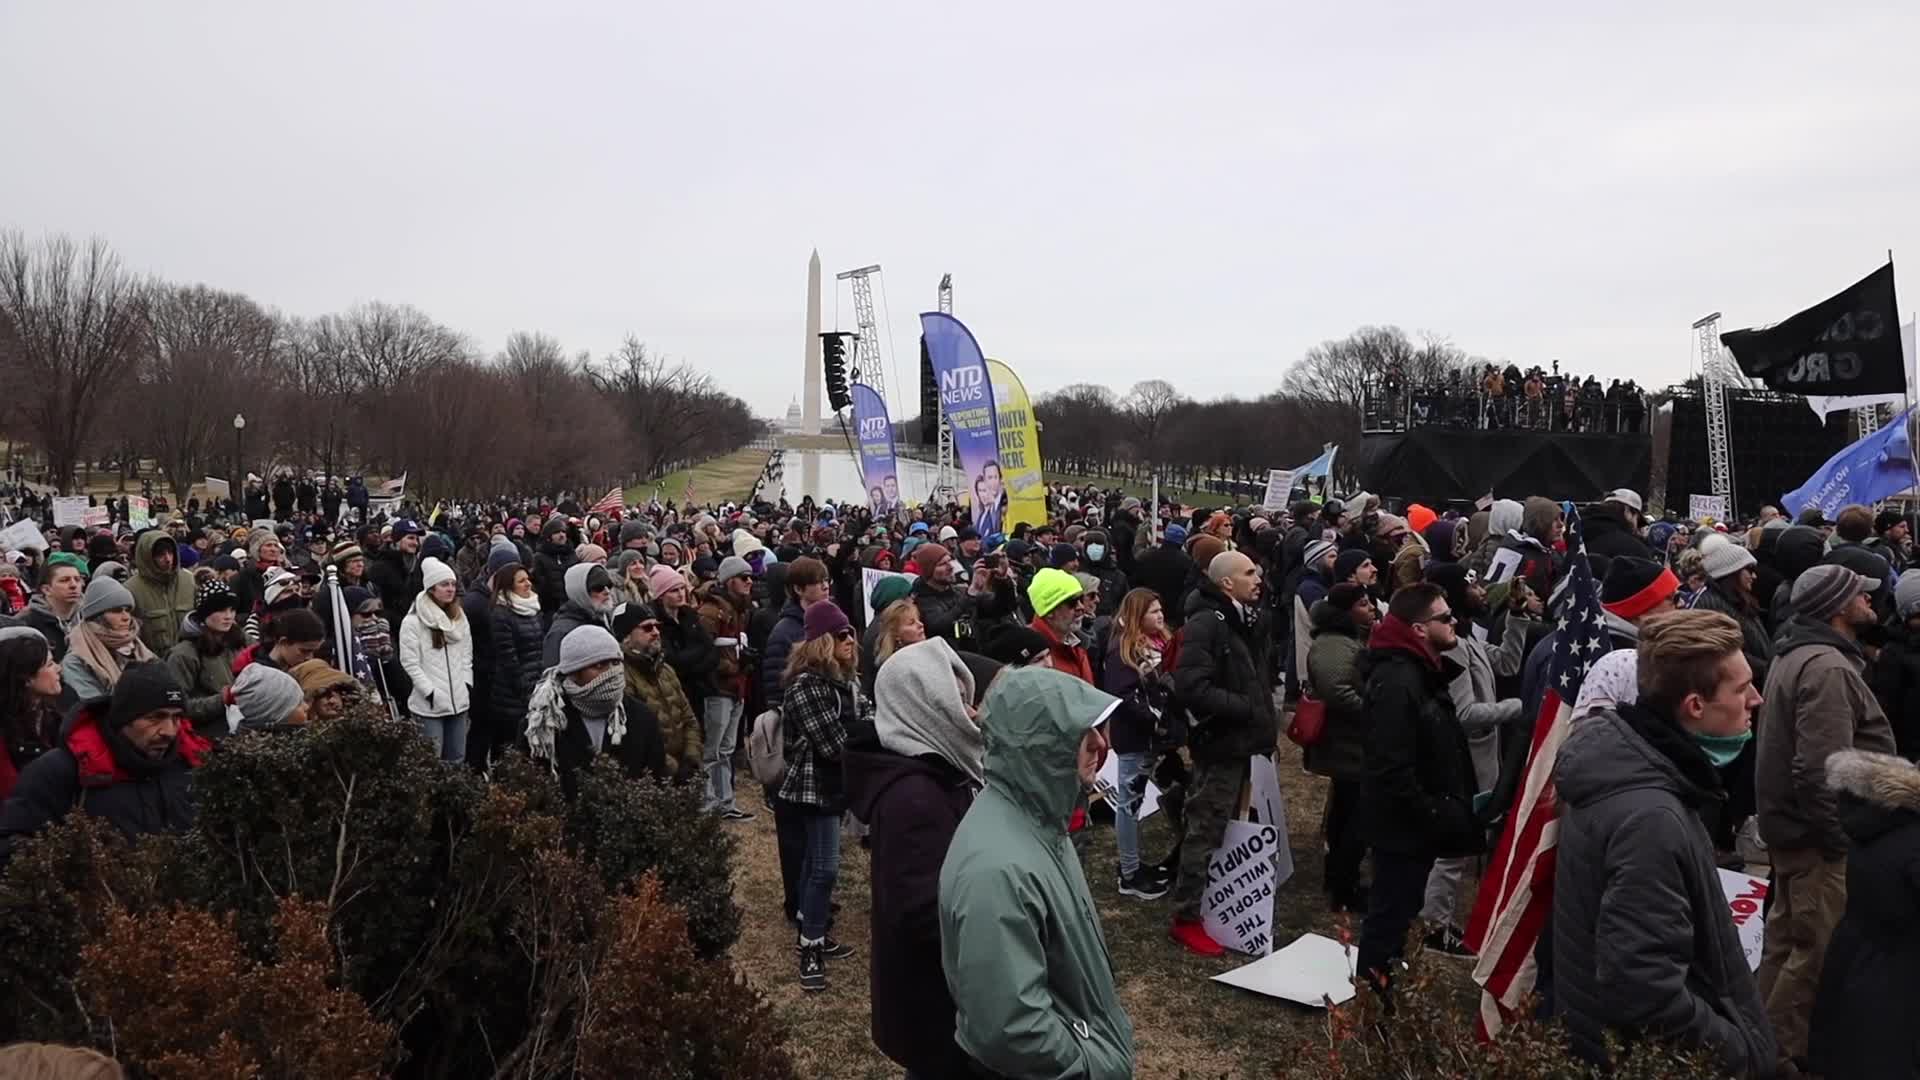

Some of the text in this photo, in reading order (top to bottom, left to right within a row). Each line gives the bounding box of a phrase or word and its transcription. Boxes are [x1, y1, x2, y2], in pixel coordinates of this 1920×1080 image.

[942, 365, 983, 391] NTD
[942, 386, 983, 404] NEWS
[860, 417, 886, 432] NTD
[998, 410, 1027, 429] RUTH
[860, 431, 886, 440] NEWS
[999, 431, 1025, 450] IVES
[1206, 826, 1277, 888] COMPLY
[1208, 861, 1269, 911] WILL NOT
[1218, 883, 1272, 924] PEOPLE
[1234, 913, 1266, 938] THE
[1246, 932, 1269, 954] WE
